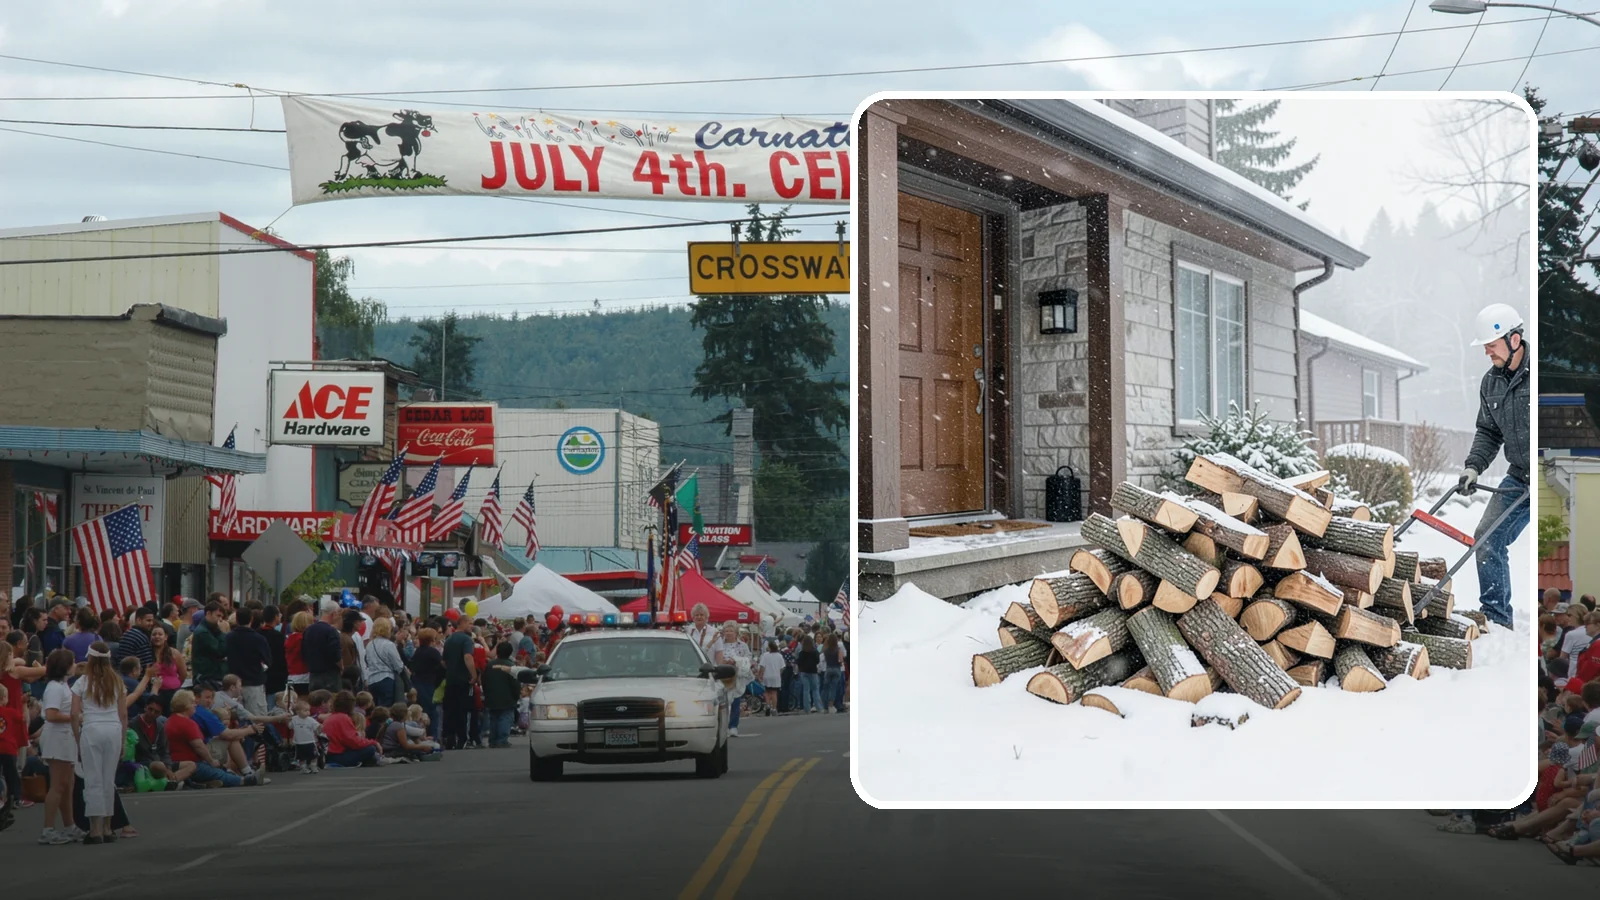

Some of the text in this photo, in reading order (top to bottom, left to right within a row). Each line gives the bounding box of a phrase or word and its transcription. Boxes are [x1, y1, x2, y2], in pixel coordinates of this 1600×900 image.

[481, 141, 605, 192] JULY
[632, 149, 746, 198] 4th.
[696, 253, 850, 280] CROSSWA
[282, 380, 374, 420] ACE
[405, 409, 485, 422] CEDAR LOG
[283, 421, 371, 436] Hardware
[416, 428, 477, 447] Coca-Cola
[353, 467, 384, 480] Simpl
[83, 484, 155, 495] St. Vincent de Paul
[688, 526, 742, 535] CRNATION
[699, 535, 730, 543] GLASS
